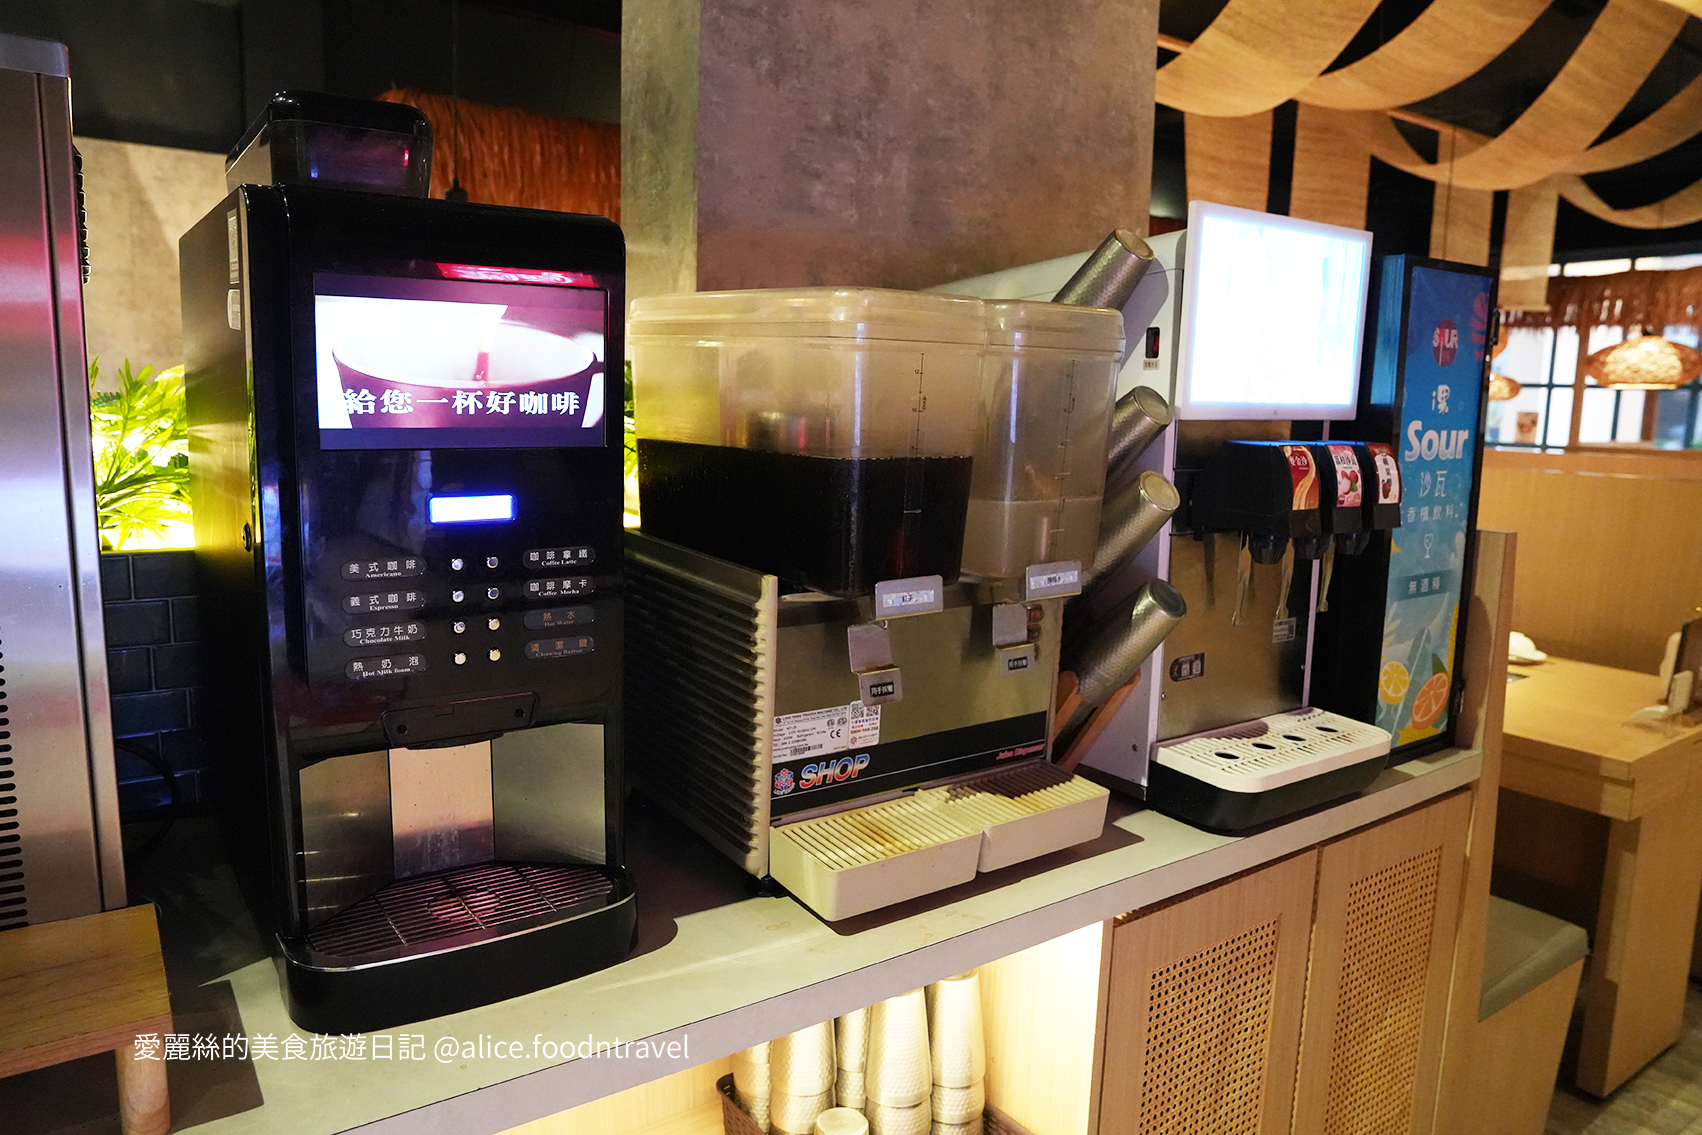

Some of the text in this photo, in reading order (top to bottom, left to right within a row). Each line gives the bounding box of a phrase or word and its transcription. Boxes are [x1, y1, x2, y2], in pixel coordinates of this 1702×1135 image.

[342, 388, 580, 415] 給您一杯好咖啡
[1404, 420, 1469, 462] Sour
[1419, 470, 1448, 497] 沙瓦
[1406, 505, 1454, 522] 香檳飲料
[530, 549, 588, 561] 咖啡拿鐵
[349, 560, 416, 574] 美式咖啡
[530, 579, 587, 592] 咖啡摩卡
[350, 592, 416, 606] 義式咖啡
[543, 610, 575, 621] 熱水
[351, 624, 418, 639] 巧克力牛奶
[352, 656, 419, 672] 熱奶泡
[996, 750, 1013, 760] Juice
[800, 754, 870, 788] SHOP
